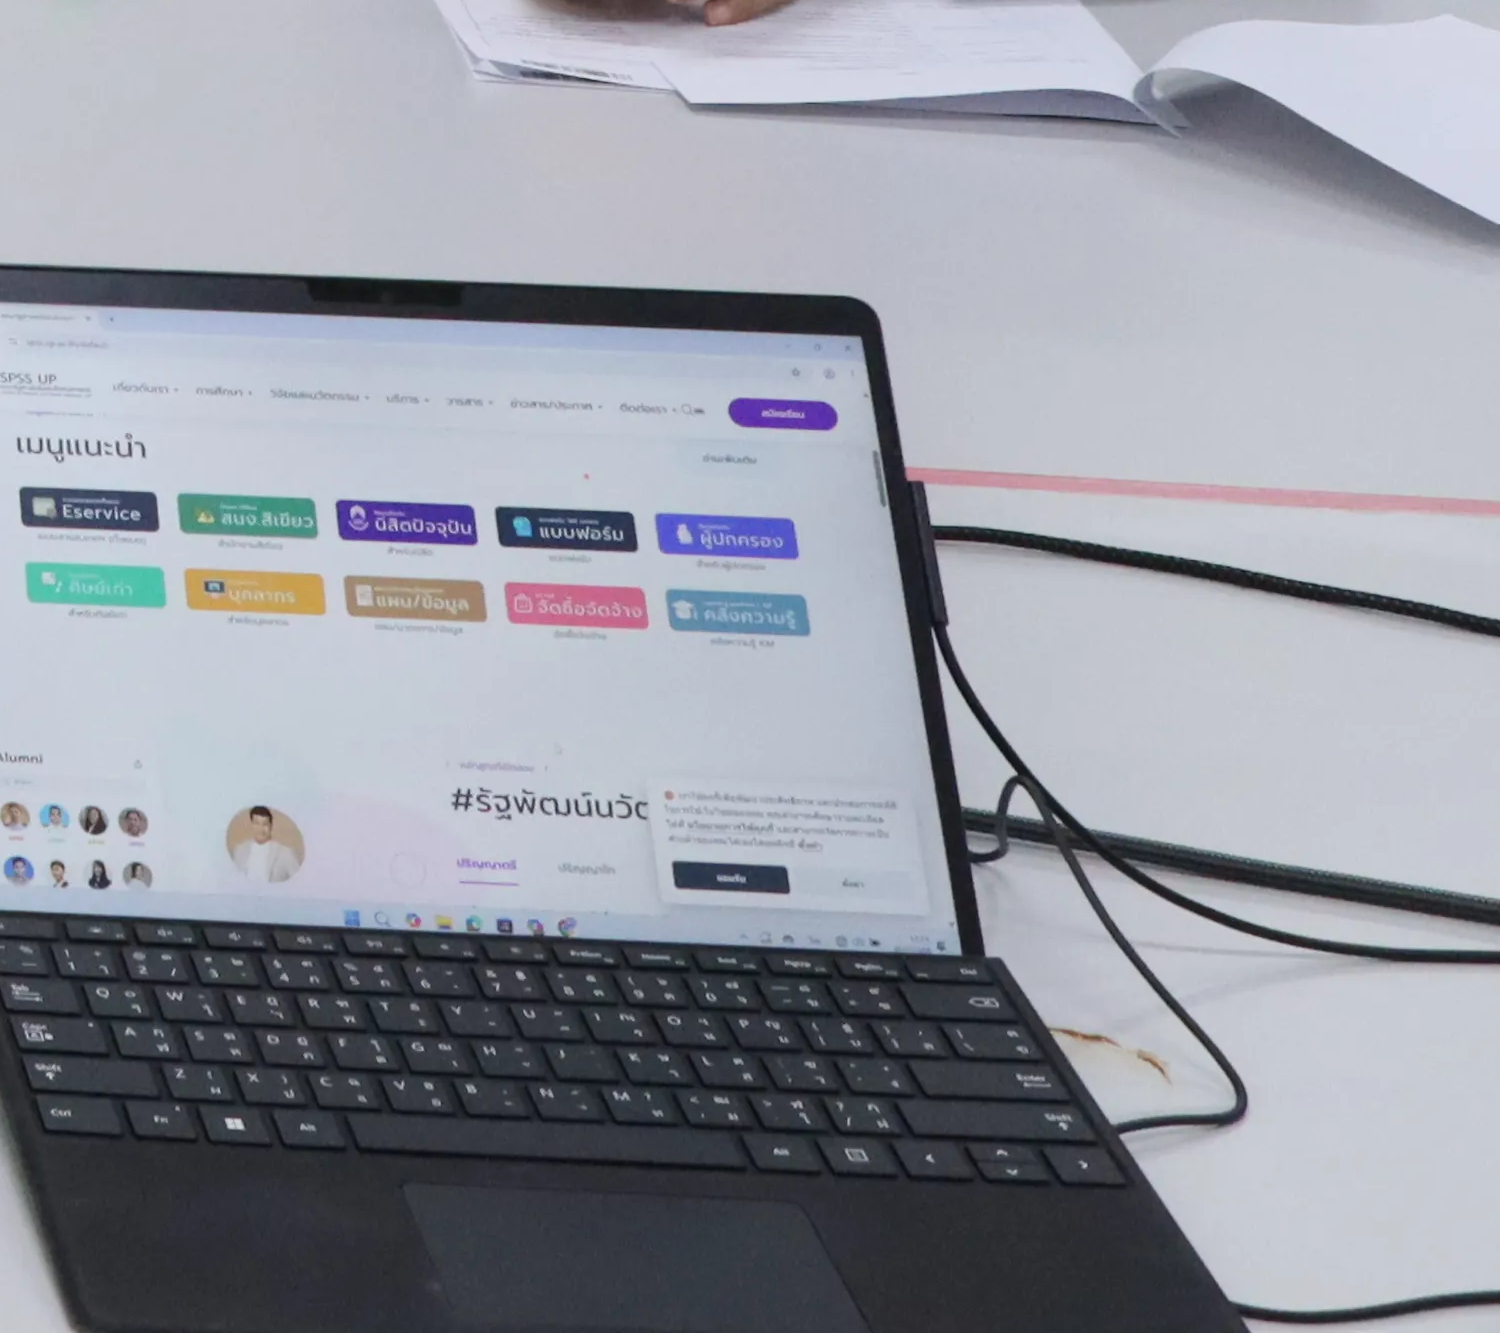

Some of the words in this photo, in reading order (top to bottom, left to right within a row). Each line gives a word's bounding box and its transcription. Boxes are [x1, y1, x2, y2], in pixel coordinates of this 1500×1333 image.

[0, 371, 33, 385] SPSS
[37, 373, 57, 386] UP
[16, 432, 148, 464] เมนูแนะนำ
[62, 503, 142, 522] Eservice
[374, 516, 473, 539] นิสิตปัจจุบัน
[539, 524, 624, 542] แบบฟอร์ม
[699, 528, 784, 550] ผู้ปกครอง
[228, 588, 296, 605] บุคลากร
[376, 593, 470, 614] แผน/ข้อมูล
[537, 595, 643, 619] จัดซื้อจัดจ้าง
[703, 607, 796, 631] คลังความรู้
[456, 857, 518, 871] ปริญญาตรี
[49, 1107, 73, 1118] Ctrl
